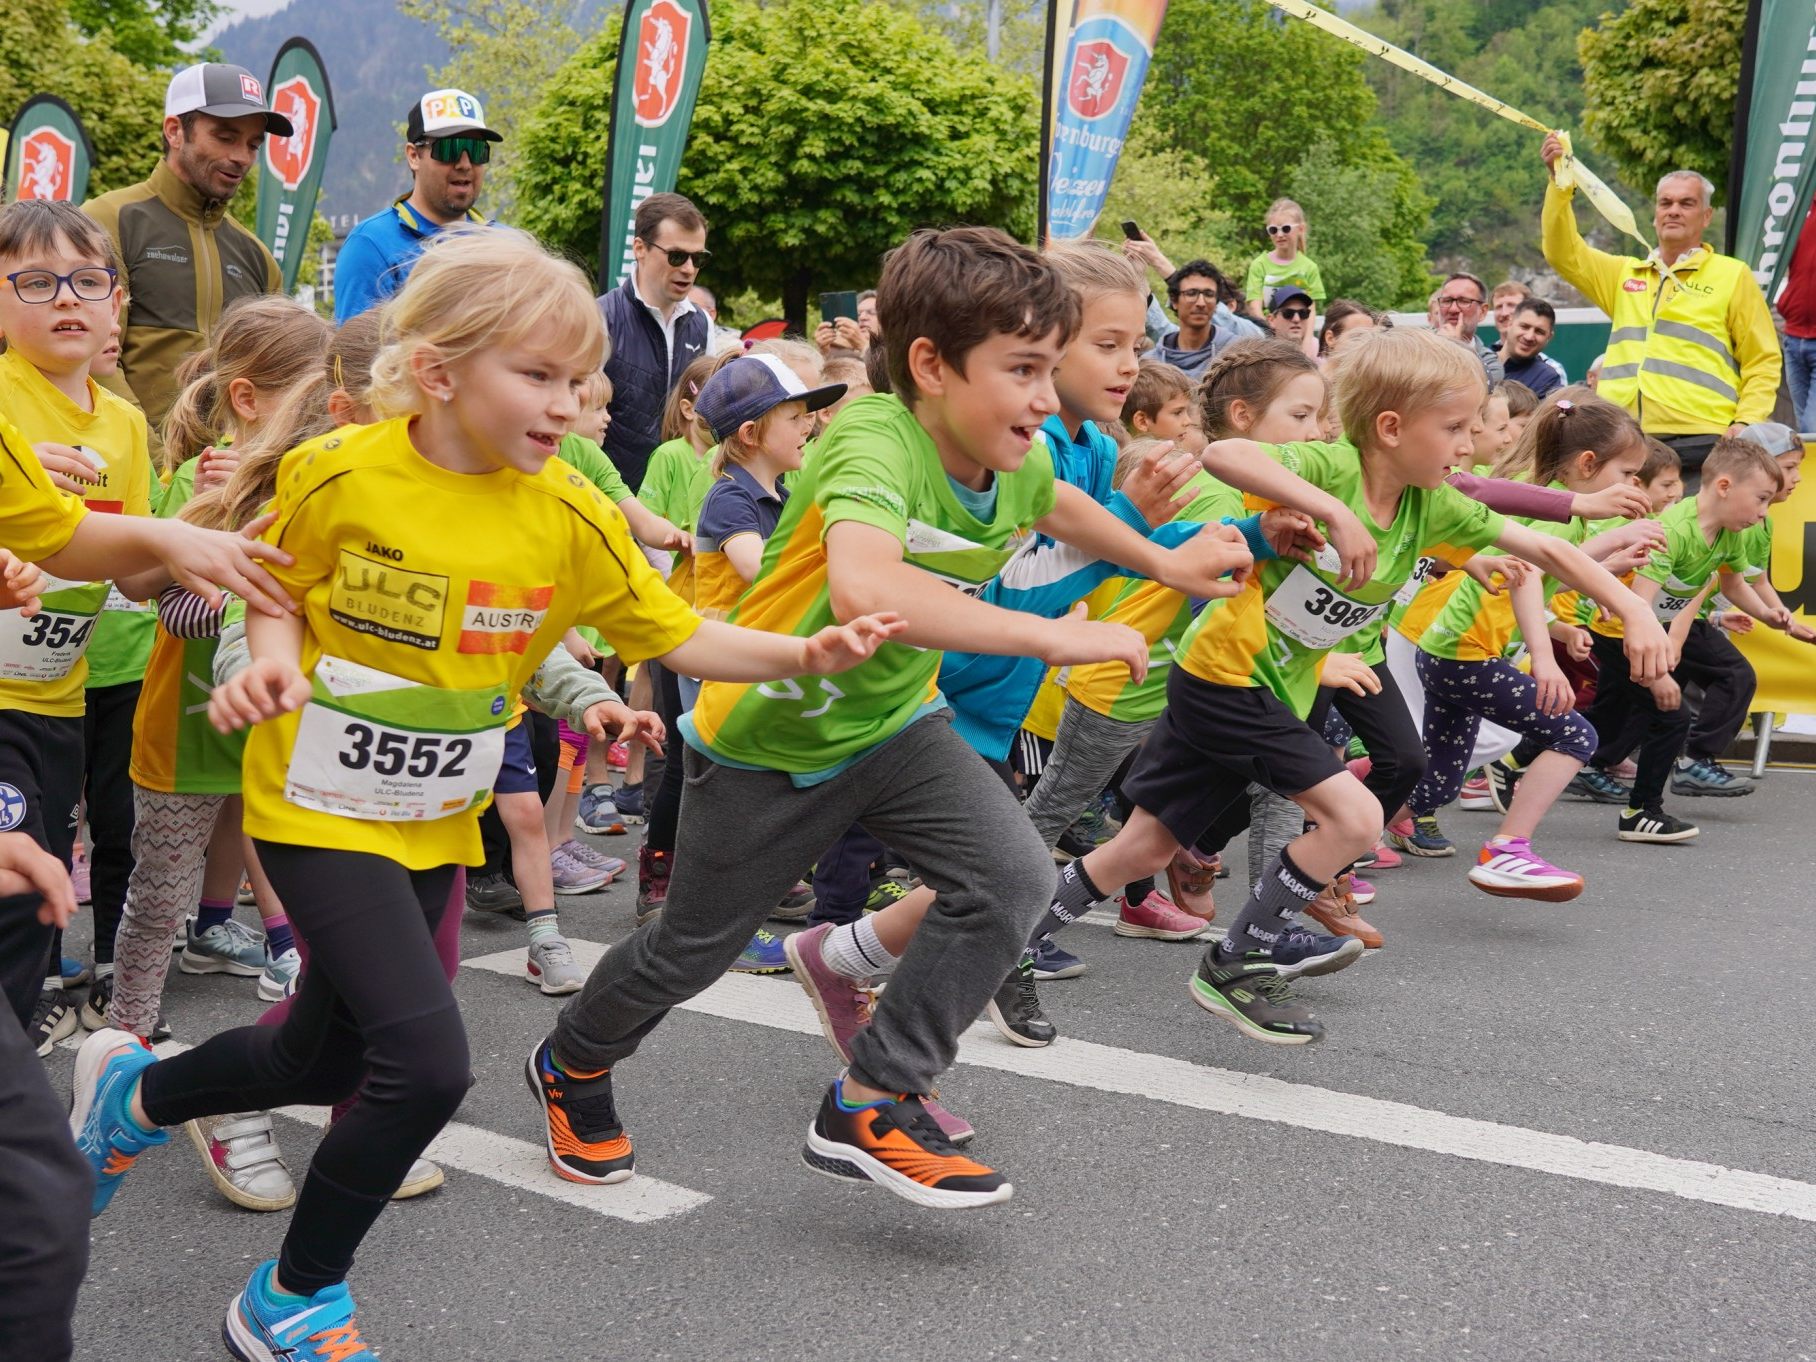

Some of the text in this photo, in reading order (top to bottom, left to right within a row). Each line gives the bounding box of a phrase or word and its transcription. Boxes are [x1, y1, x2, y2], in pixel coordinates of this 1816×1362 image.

[366, 541, 403, 562] JAKO
[342, 566, 441, 612] ULC
[346, 597, 425, 627] BLUDENZ
[1304, 587, 1379, 628] 3989
[22, 613, 100, 649] 354
[331, 613, 437, 648] www.ulc-bludenz.at
[338, 722, 473, 778] 3552
